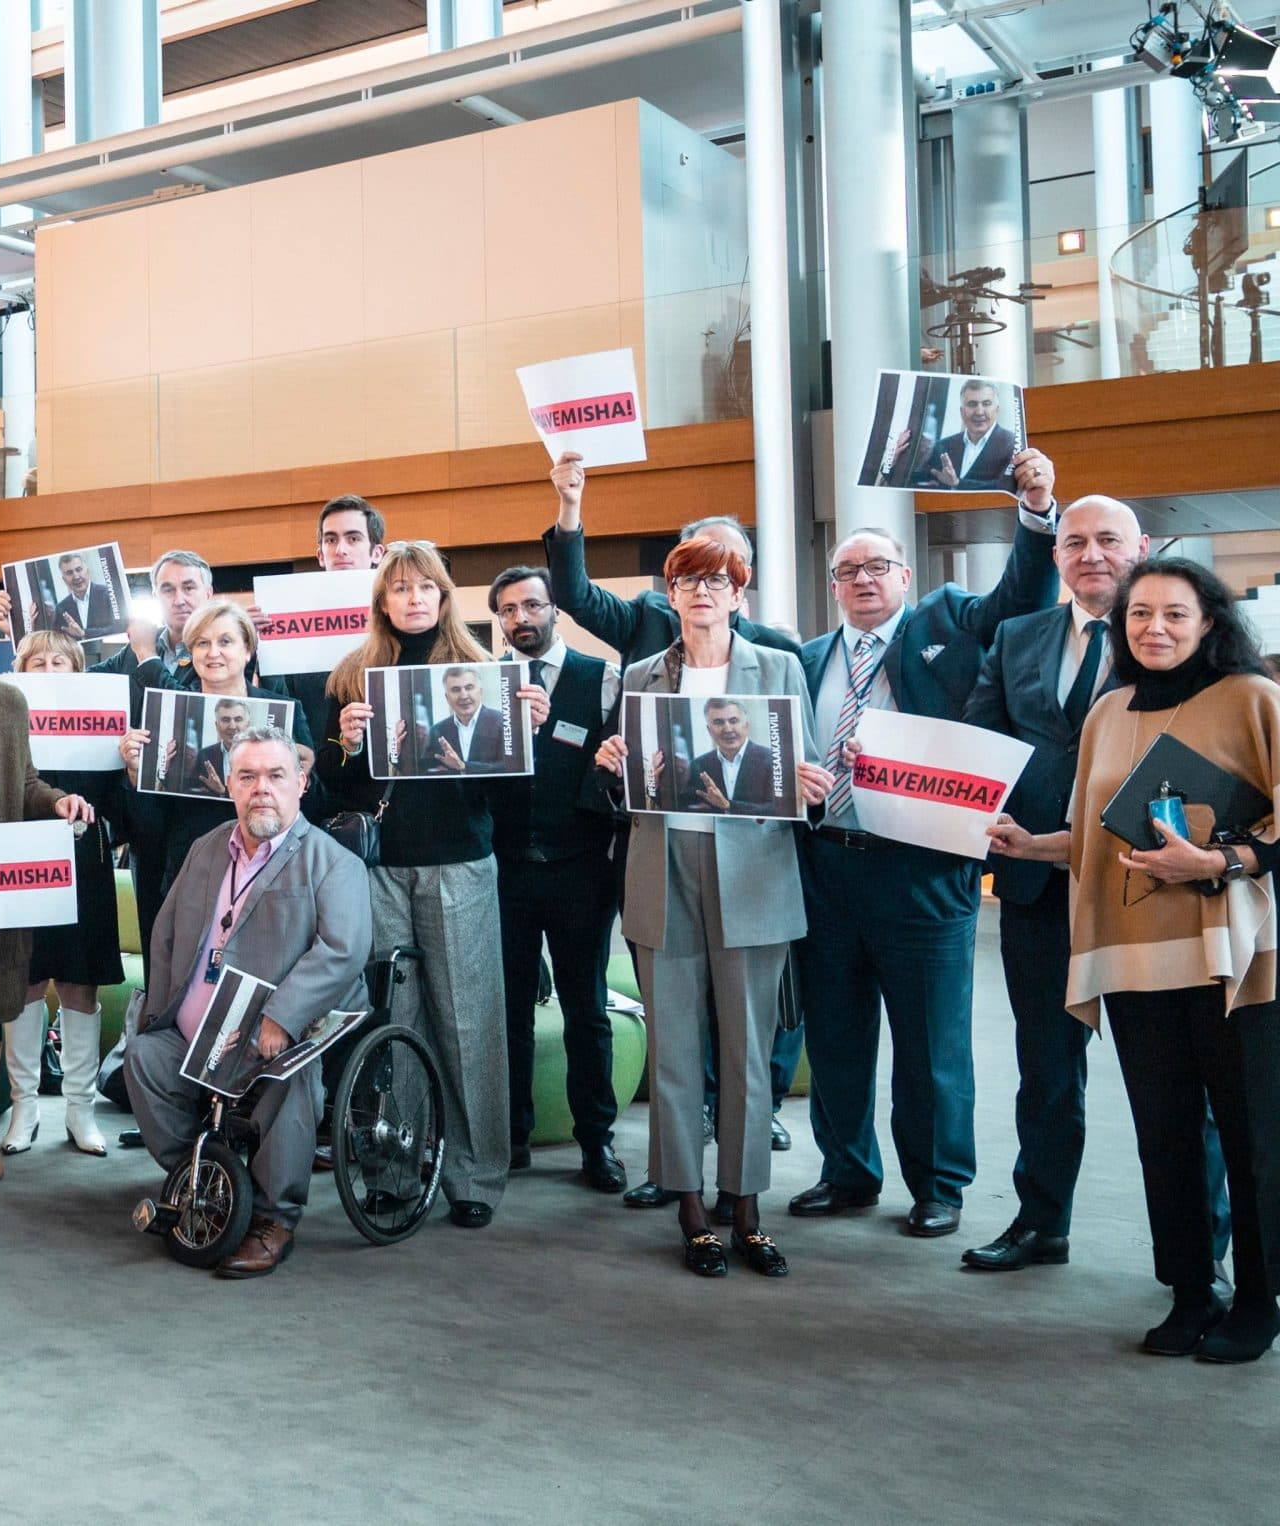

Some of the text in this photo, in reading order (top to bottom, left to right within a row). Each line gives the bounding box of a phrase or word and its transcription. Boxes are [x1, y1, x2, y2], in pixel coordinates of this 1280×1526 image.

[501, 677, 513, 756] #FREESAAKASHVILI
[768, 712, 783, 797] #FREESAAKASHVILI
[854, 763, 1000, 806] #SAVEMISHA!
